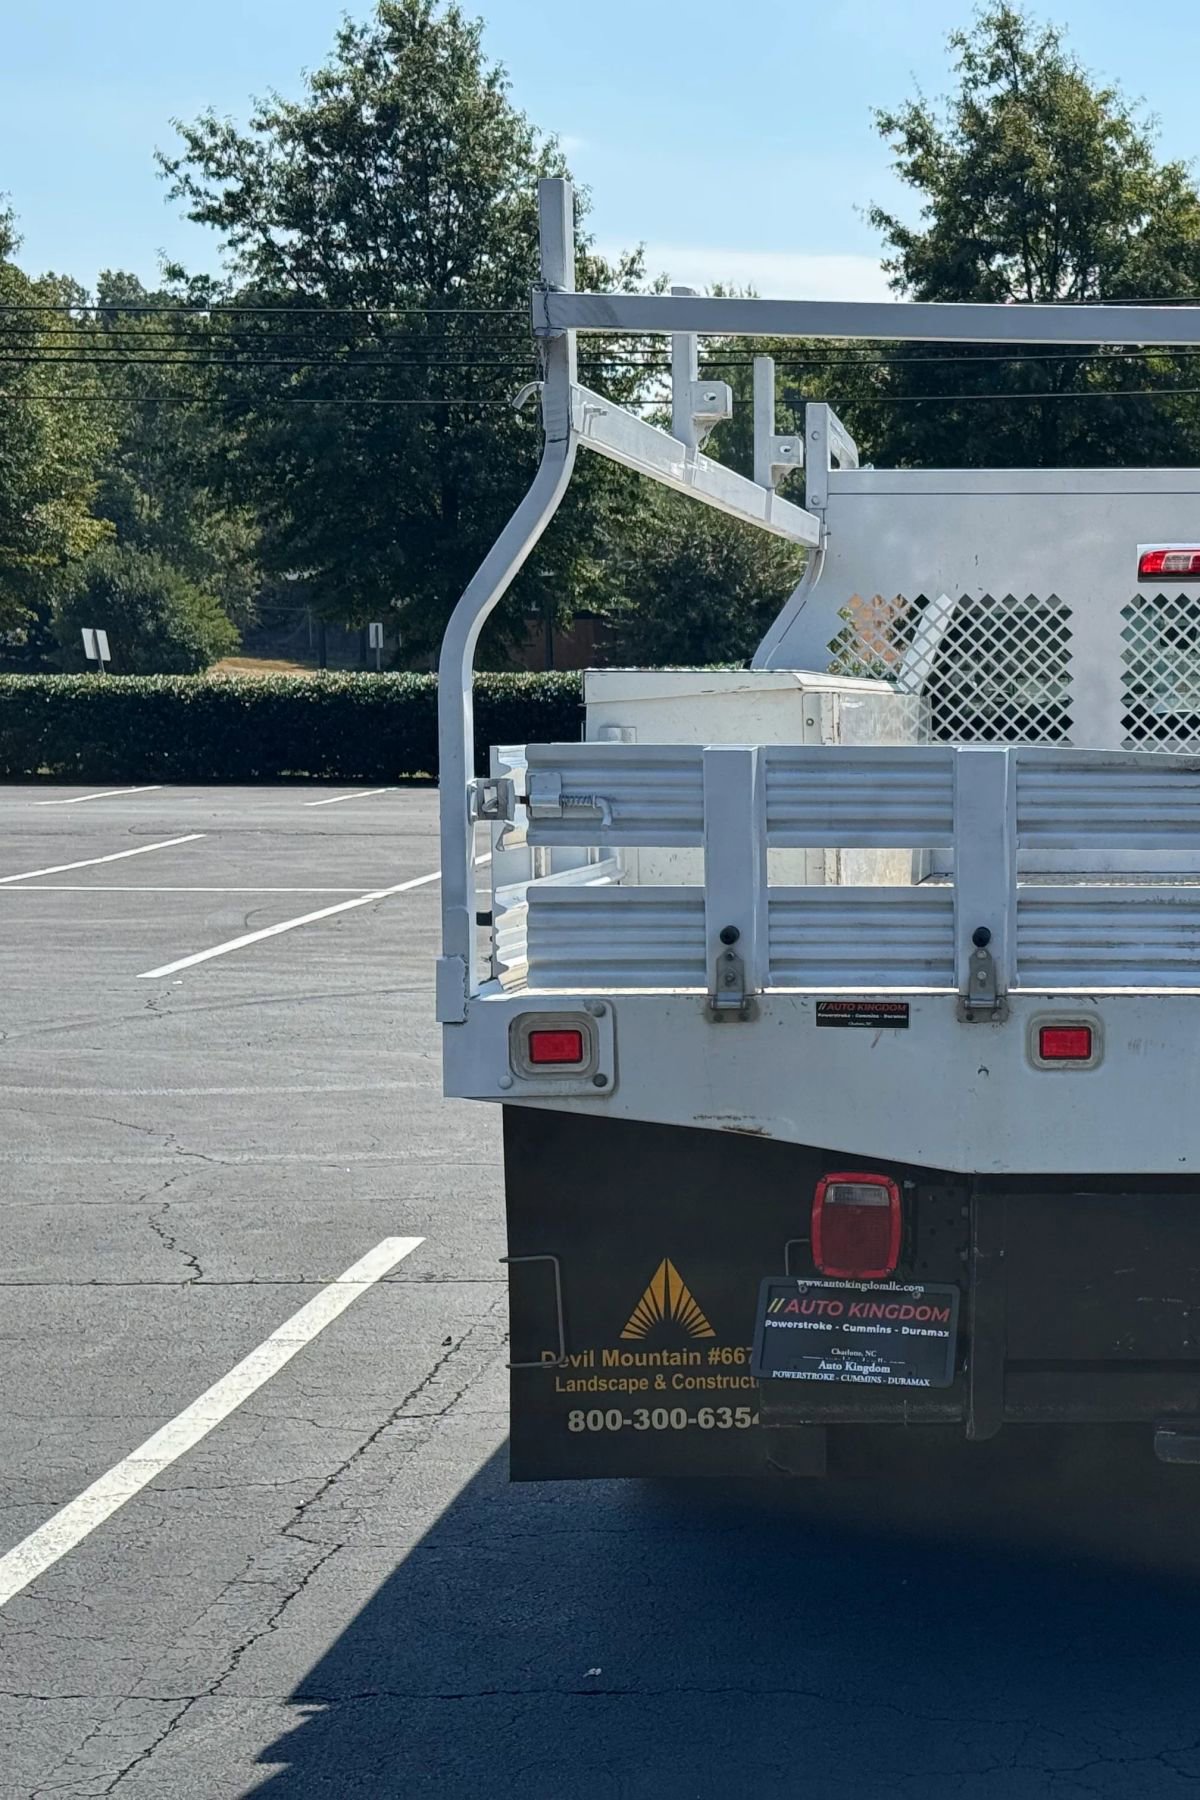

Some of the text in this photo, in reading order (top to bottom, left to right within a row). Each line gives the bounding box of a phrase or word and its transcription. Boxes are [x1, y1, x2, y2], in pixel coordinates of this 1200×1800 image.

[826, 1003, 906, 1012] AUTO KINGDOM
[797, 1279, 925, 1293] www.autokingdomllc.com
[784, 1298, 951, 1323] AUTO KINGDOM
[765, 1319, 833, 1331] Powerstroke
[842, 1323, 892, 1335] Cummins
[901, 1326, 950, 1338] Duramax
[602, 1348, 701, 1367] Mountain
[818, 1360, 843, 1371] Auto
[844, 1361, 891, 1375] Kingdom
[555, 1374, 649, 1395] Landscape
[654, 1374, 667, 1390] &
[772, 1370, 835, 1381] POWERSTROKE
[840, 1374, 882, 1384] CUMMINS
[888, 1376, 931, 1387] DURAMAX
